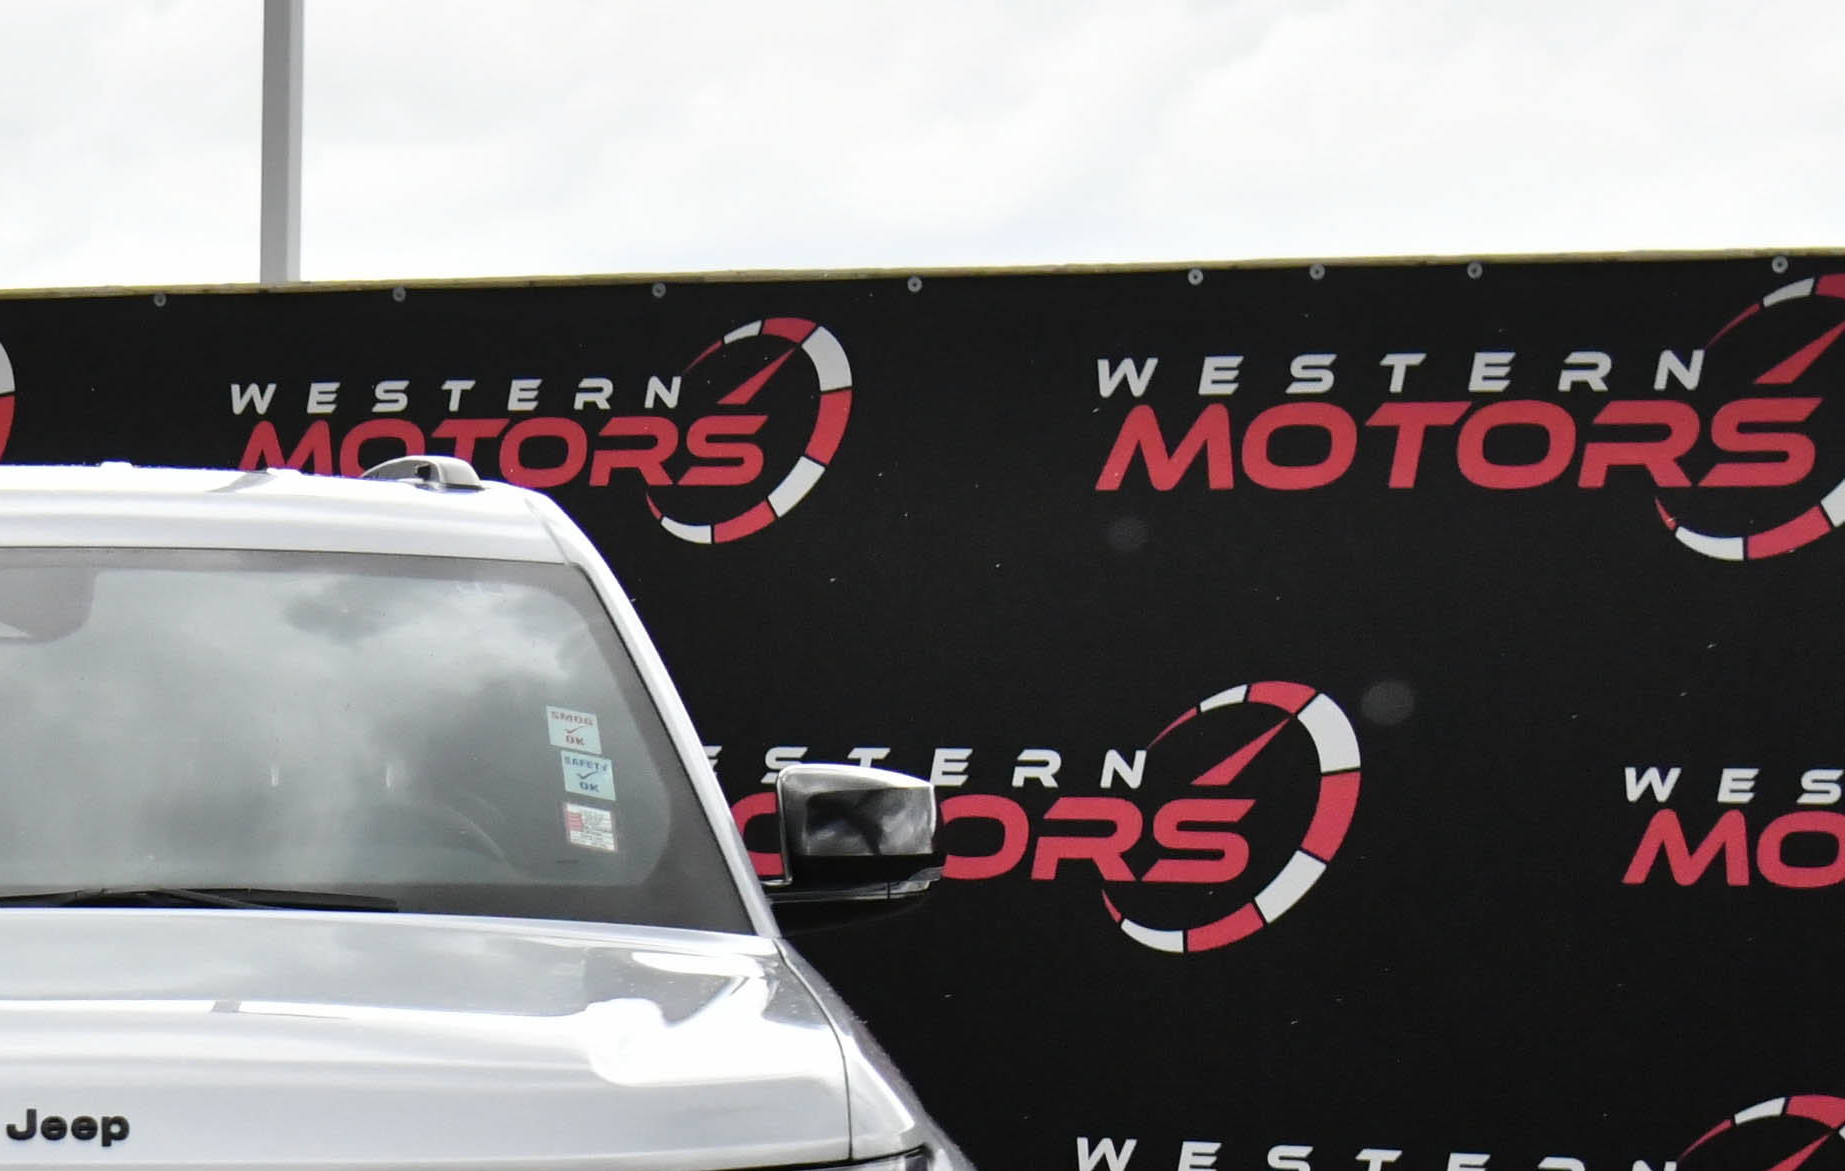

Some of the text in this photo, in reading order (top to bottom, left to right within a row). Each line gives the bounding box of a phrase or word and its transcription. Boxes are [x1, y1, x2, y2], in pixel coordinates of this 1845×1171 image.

[230, 376, 683, 416] WESTERN
[1096, 349, 1706, 399] WESTERN
[238, 415, 769, 490] MOTORS
[1094, 397, 1824, 492] MOTORS
[578, 781, 600, 793] OK
[6, 1108, 130, 1147] Jeep
